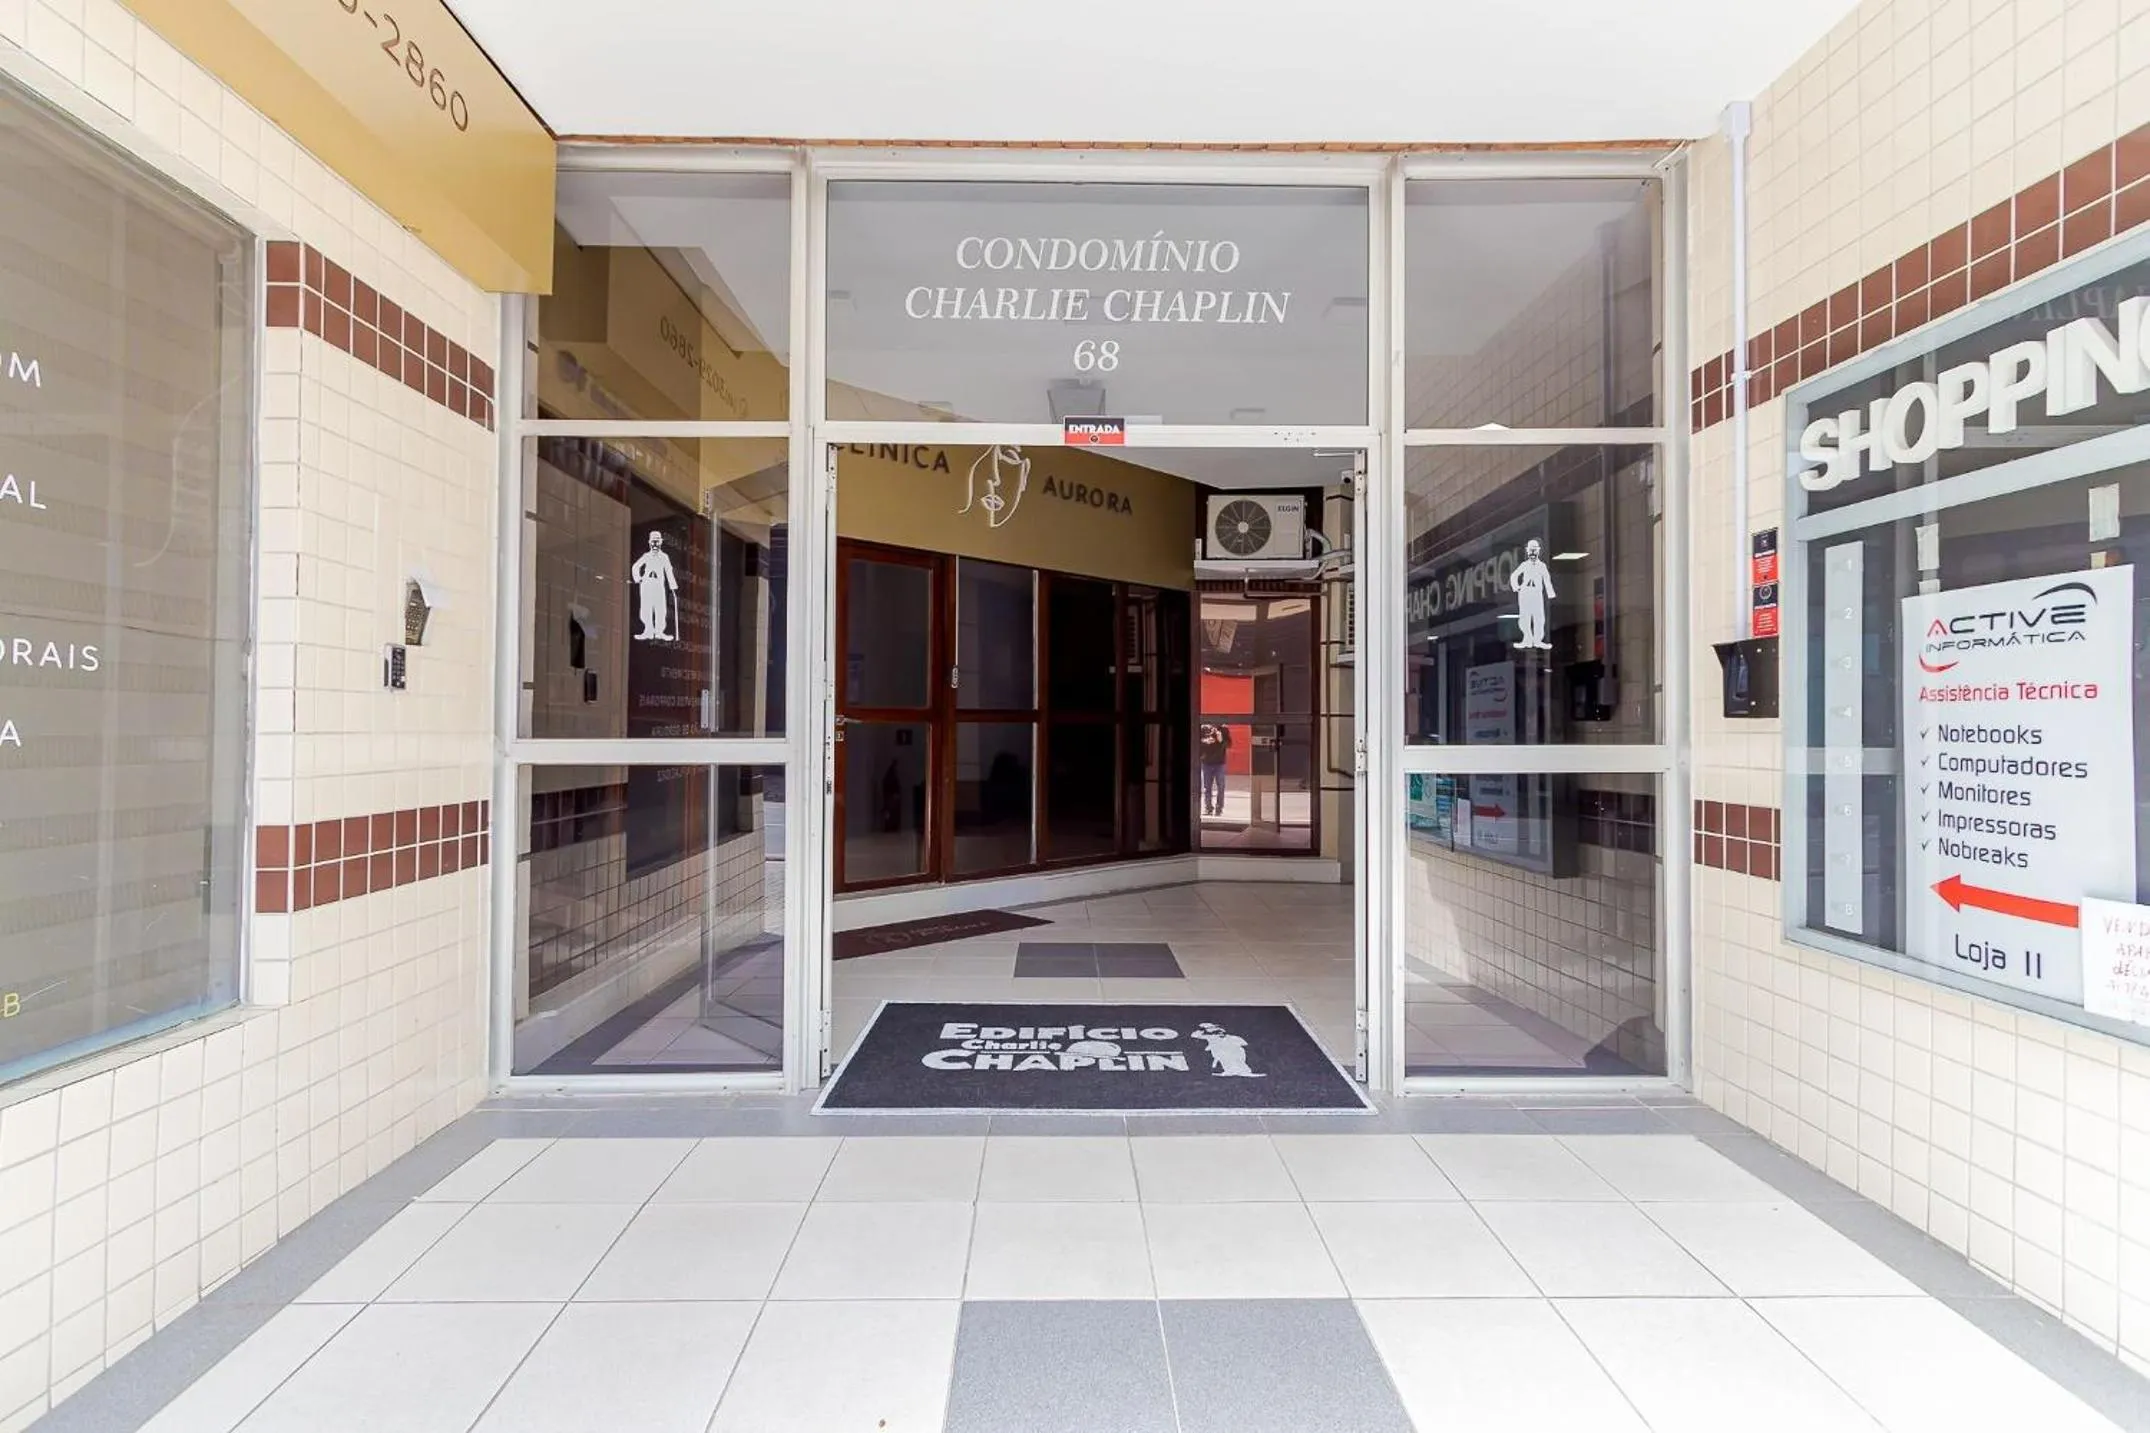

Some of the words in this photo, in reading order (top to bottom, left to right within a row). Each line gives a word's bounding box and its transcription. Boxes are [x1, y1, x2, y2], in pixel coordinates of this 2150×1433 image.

[955, 229, 1240, 273] CONDOMÍNIO
[904, 286, 1091, 320] CHARLIE
[1103, 289, 1292, 324] CHAPLIN
[0, 351, 41, 388] M
[1072, 340, 1120, 371] 68
[1800, 296, 2150, 491] SHOPPIN
[1068, 424, 1121, 434] ENTRADA
[829, 442, 950, 474] LINICA
[1042, 474, 1134, 516] AURORA
[1277, 504, 1300, 513] ELGIN
[1927, 604, 2087, 637] ACTIVE
[1925, 631, 2086, 653] INFORMÁTICA
[1919, 681, 2010, 702] Assistência
[2015, 680, 2099, 701] Técnica
[1938, 724, 2043, 745] Notebooks
[1938, 752, 2089, 779] Computadores
[1938, 781, 2032, 807] Monitores
[1938, 809, 2057, 841] Impressoras
[1938, 837, 2029, 868] Nobreaks
[1955, 933, 2006, 970] Loja
[940, 1022, 1180, 1040] EDIFÍCIO
[921, 1049, 1190, 1071] CHAPLIN
